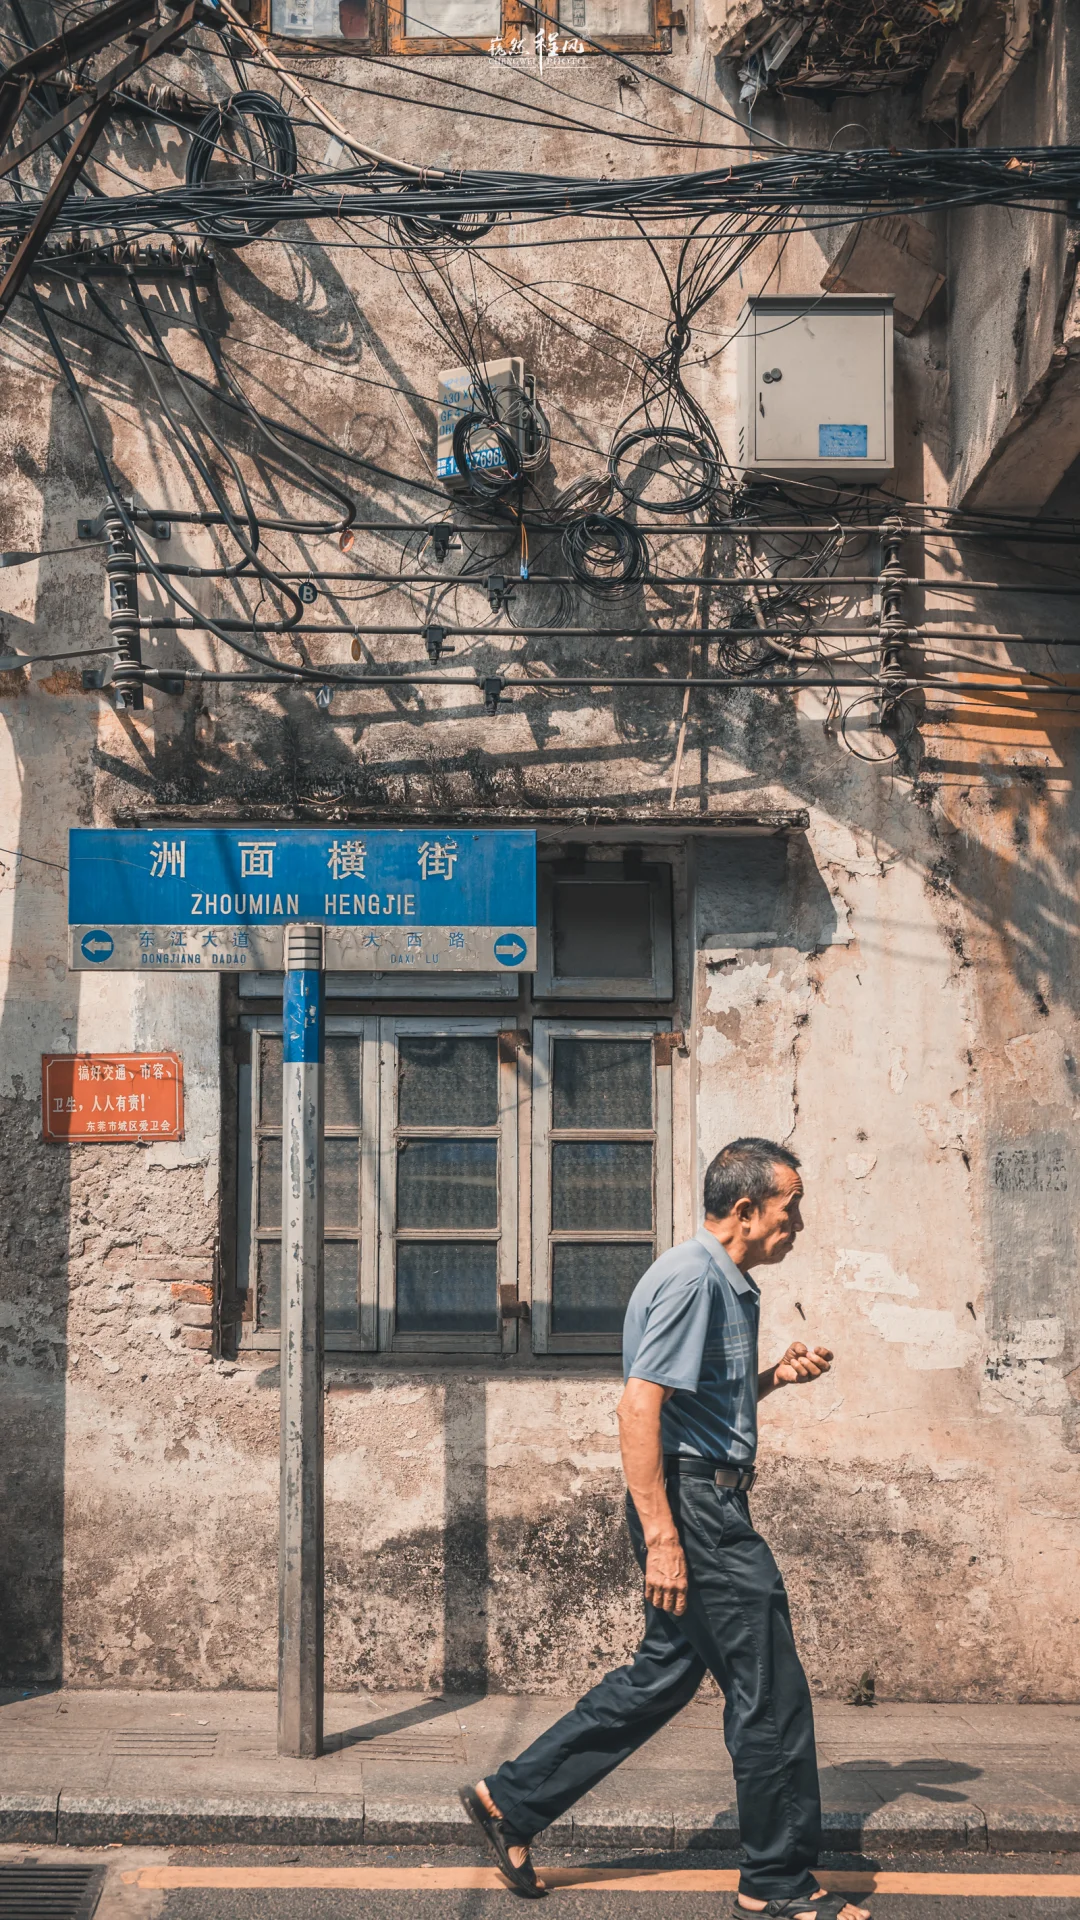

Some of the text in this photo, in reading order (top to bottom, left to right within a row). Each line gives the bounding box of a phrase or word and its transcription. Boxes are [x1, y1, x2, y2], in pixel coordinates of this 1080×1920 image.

[303, 585, 313, 601] B
[149, 839, 458, 880] 洲面横街
[191, 893, 416, 915] ZHOUMIAN HENGJIE
[139, 930, 250, 948] 东江大道
[362, 931, 466, 949] 大西路
[141, 953, 247, 965] DONGJIANG DADAO
[389, 953, 440, 964] DAXI LU
[85, 1119, 171, 1133] 东莞市城区爱卫会
